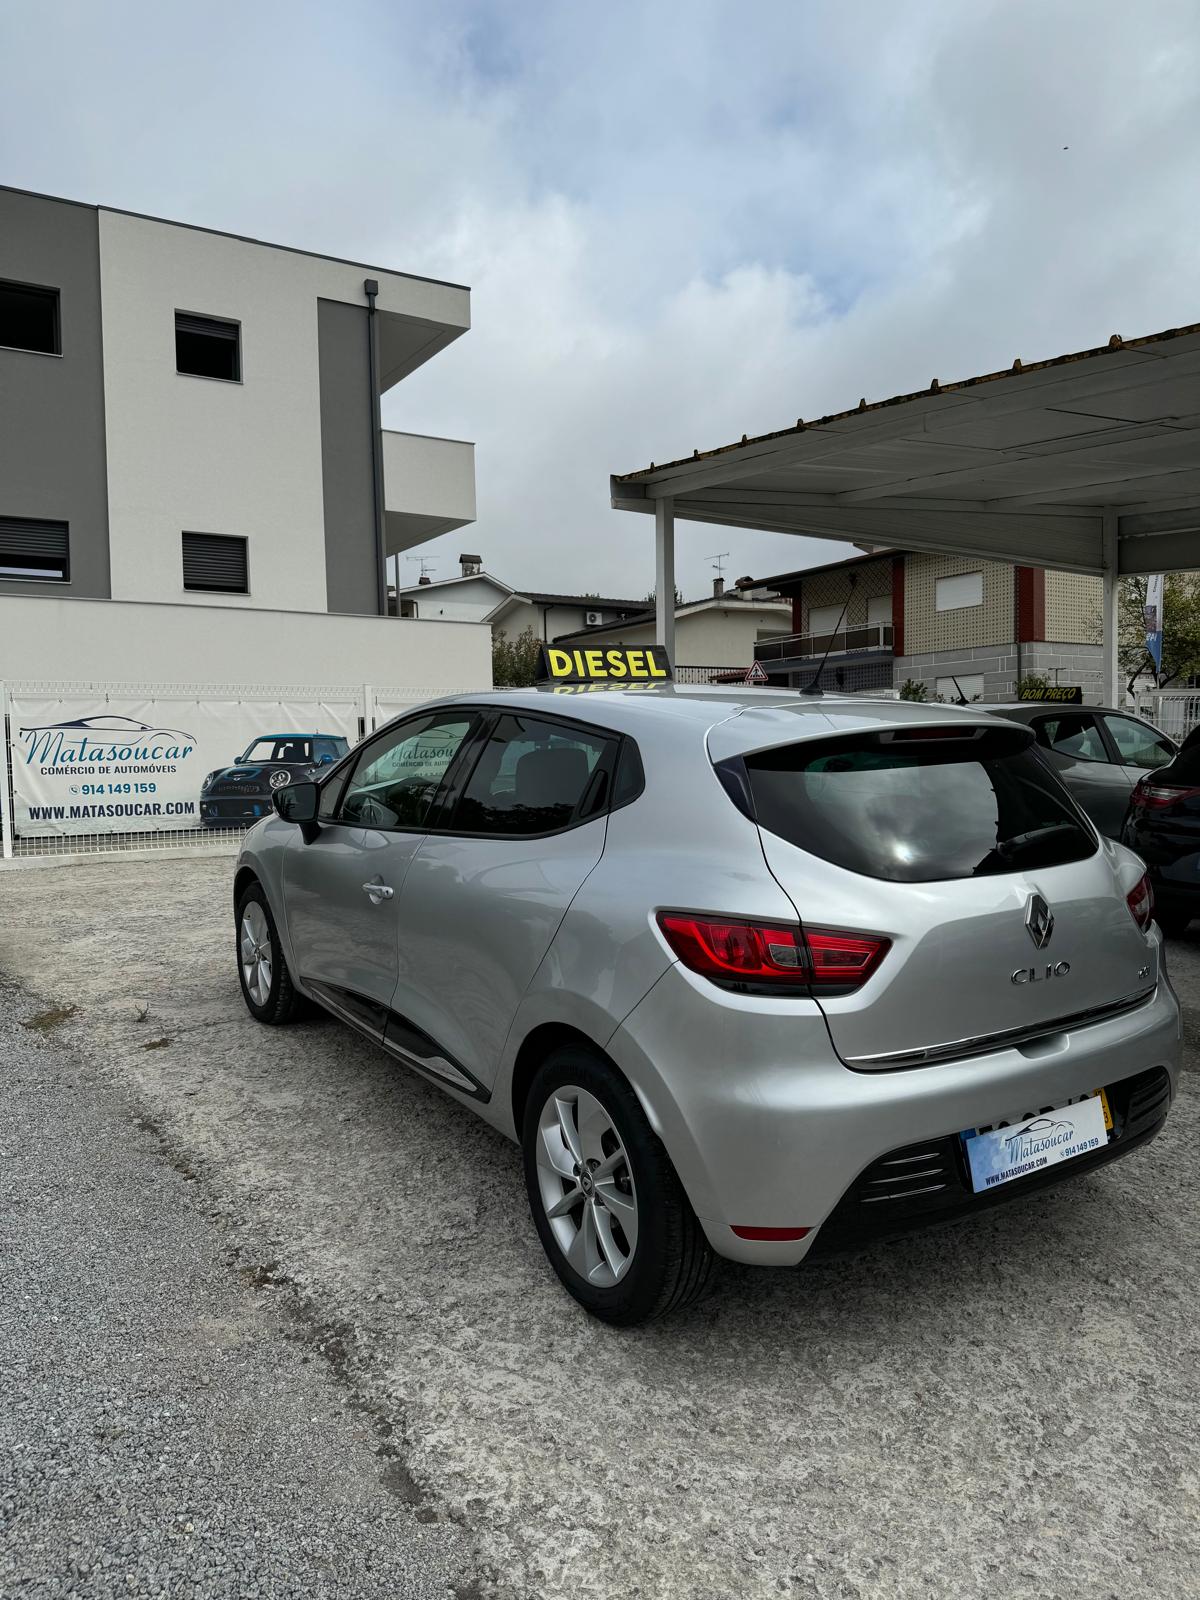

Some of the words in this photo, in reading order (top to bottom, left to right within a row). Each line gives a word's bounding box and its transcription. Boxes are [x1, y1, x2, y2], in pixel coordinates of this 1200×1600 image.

[548, 649, 667, 677] DIESEL
[1021, 688, 1043, 700] BOM
[1044, 688, 1077, 701] PREÇO
[20, 731, 193, 766] Matasoucar
[388, 742, 453, 761] Matasou
[40, 765, 95, 776] COMÉRCIO
[98, 765, 111, 775] DE
[113, 763, 177, 775] AUTOMÓVEIS
[81, 784, 105, 795] 914
[108, 783, 131, 795] 149
[133, 782, 156, 794] 159
[29, 802, 195, 820] WWW.MATASOUCAR.COM
[1011, 961, 1070, 985] CLIO
[1005, 1130, 1074, 1163] Matasoucar
[1065, 1146, 1076, 1157] 914
[1076, 1142, 1087, 1153] 149
[1088, 1137, 1099, 1149] 159
[985, 1157, 1047, 1185] WWW.MATASOUCAR.COM
